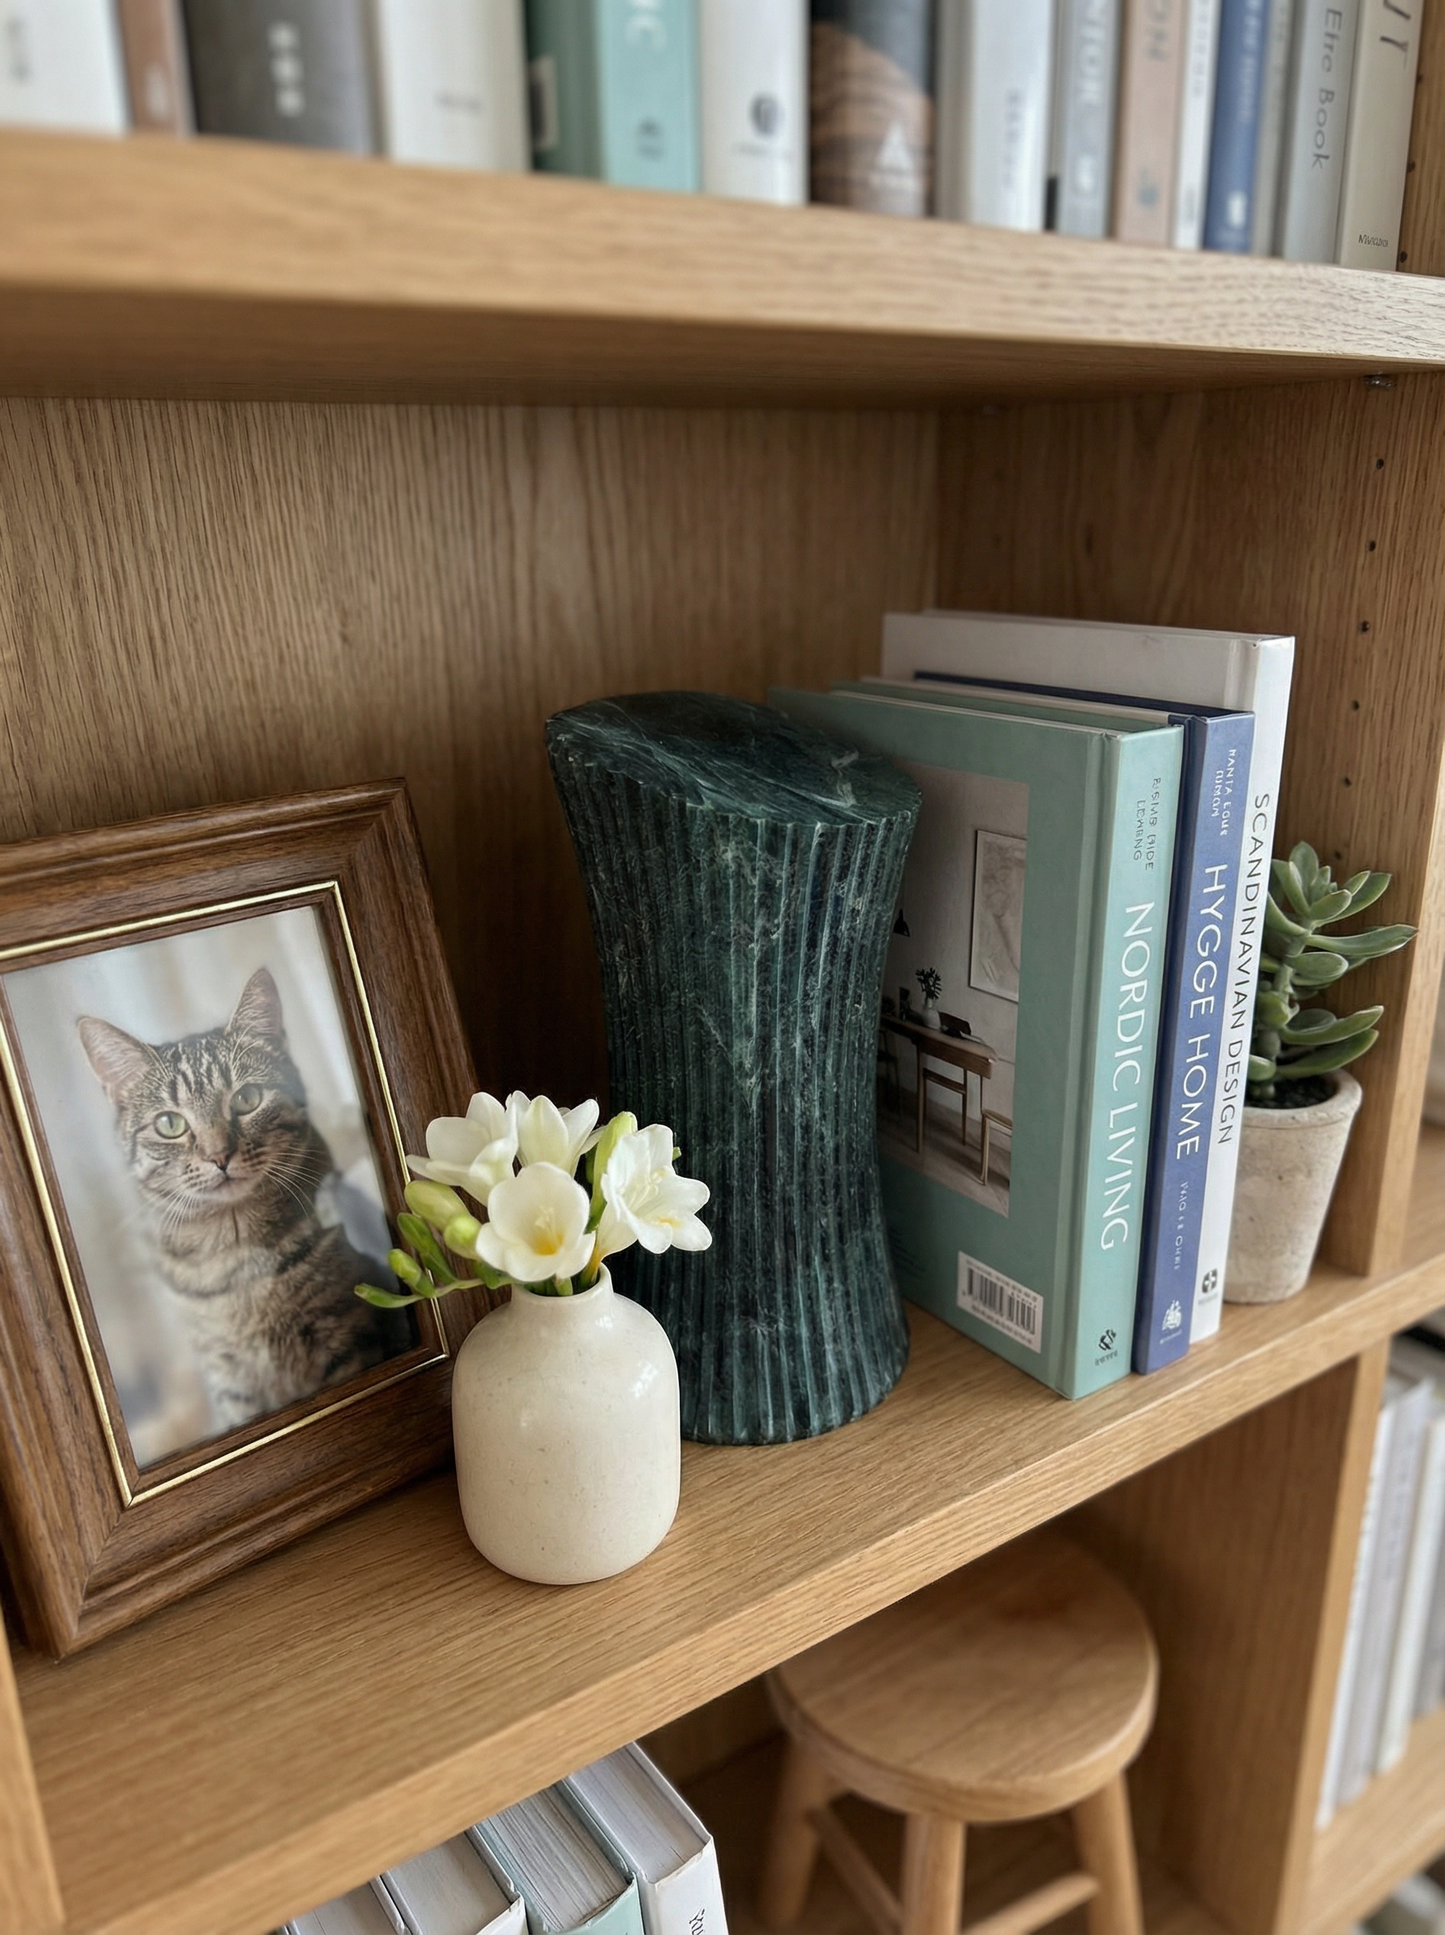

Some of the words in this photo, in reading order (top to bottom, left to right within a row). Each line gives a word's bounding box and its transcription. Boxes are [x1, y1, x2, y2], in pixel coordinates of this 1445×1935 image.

[1311, 86, 1336, 170] Book
[1189, 863, 1228, 1019] HYGGE
[1230, 793, 1270, 1030] SCANDINAVIAN
[1112, 901, 1155, 1092] NORDIC
[1176, 1033, 1211, 1160] HOME
[1217, 1039, 1243, 1144] DESIGN
[1100, 1102, 1138, 1251] LIVING
